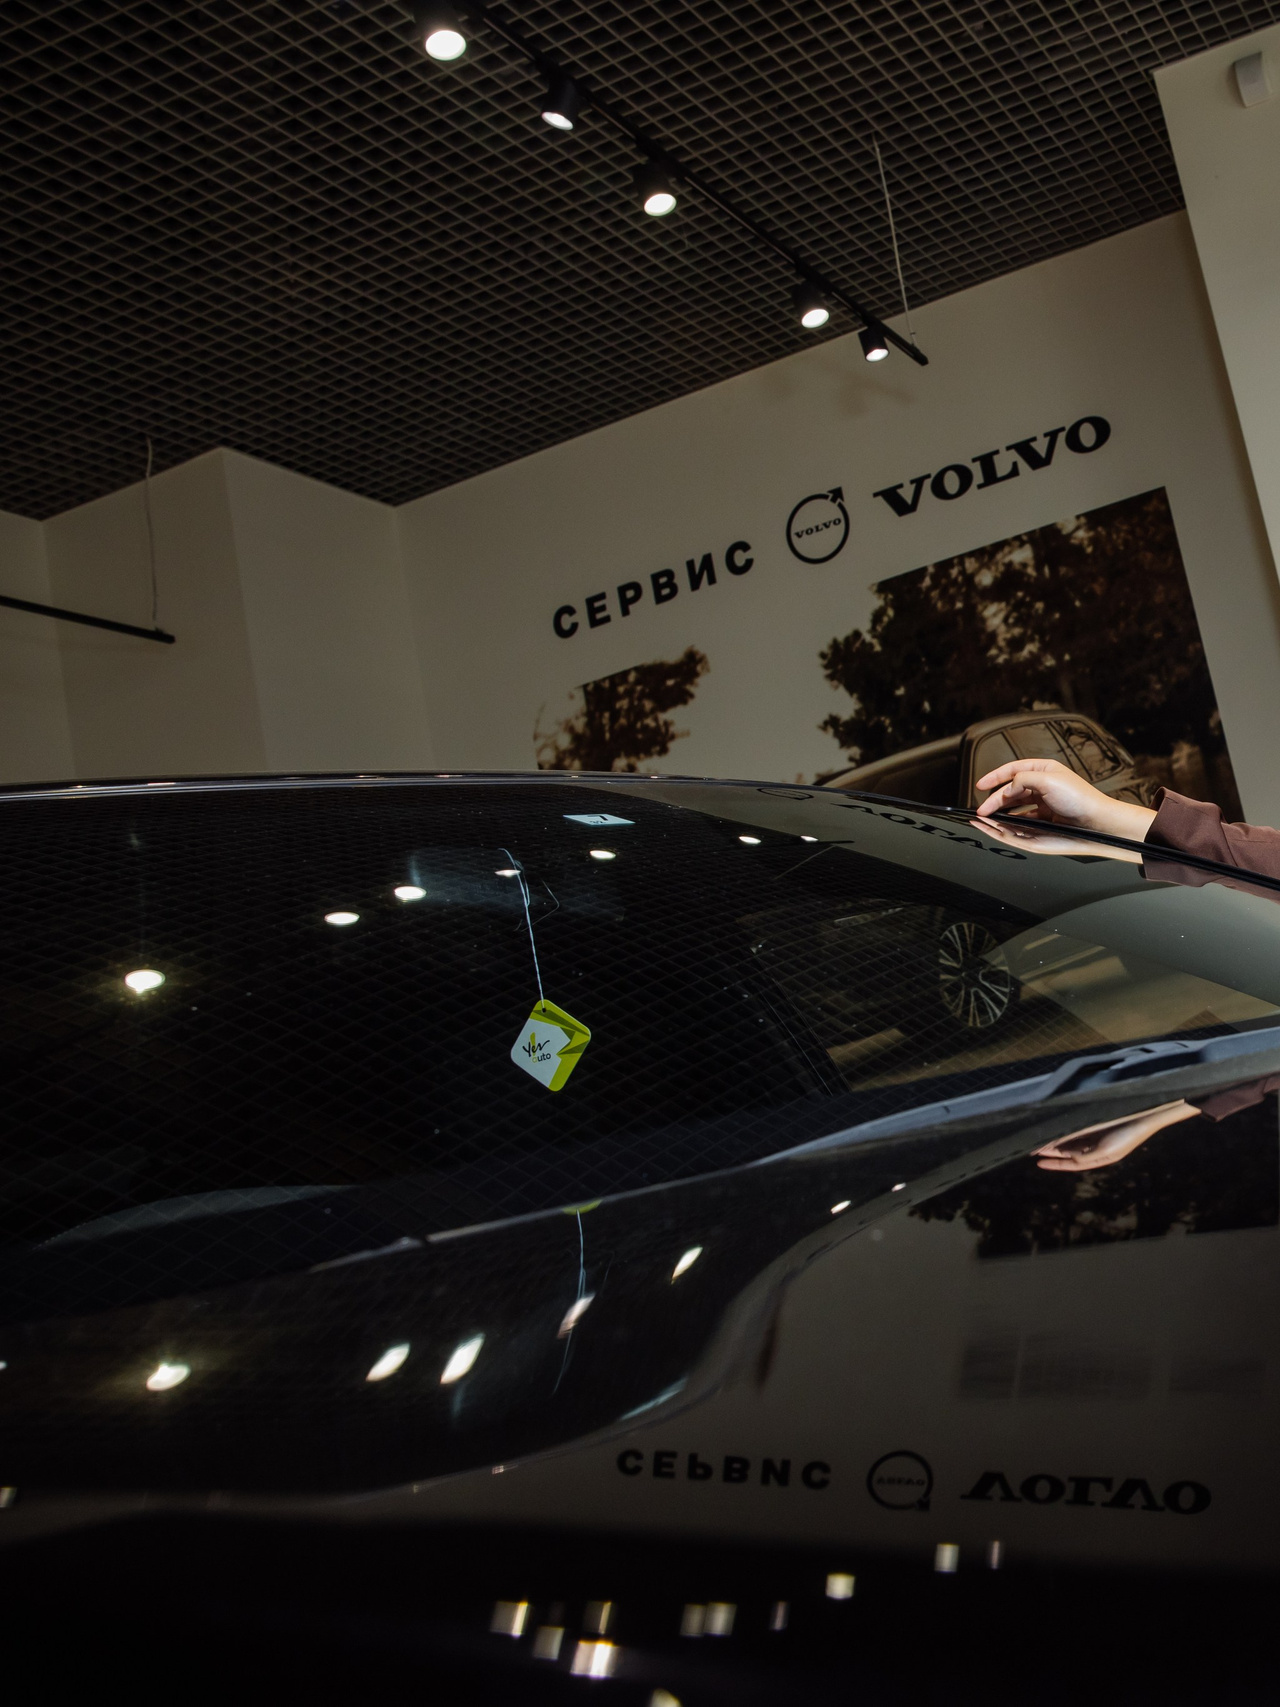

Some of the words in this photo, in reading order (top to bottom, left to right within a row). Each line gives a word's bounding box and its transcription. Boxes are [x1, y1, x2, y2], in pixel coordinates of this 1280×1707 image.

[873, 416, 1111, 517] VOLVO
[794, 518, 842, 539] VOLVO
[553, 541, 754, 639] СЕРВИС
